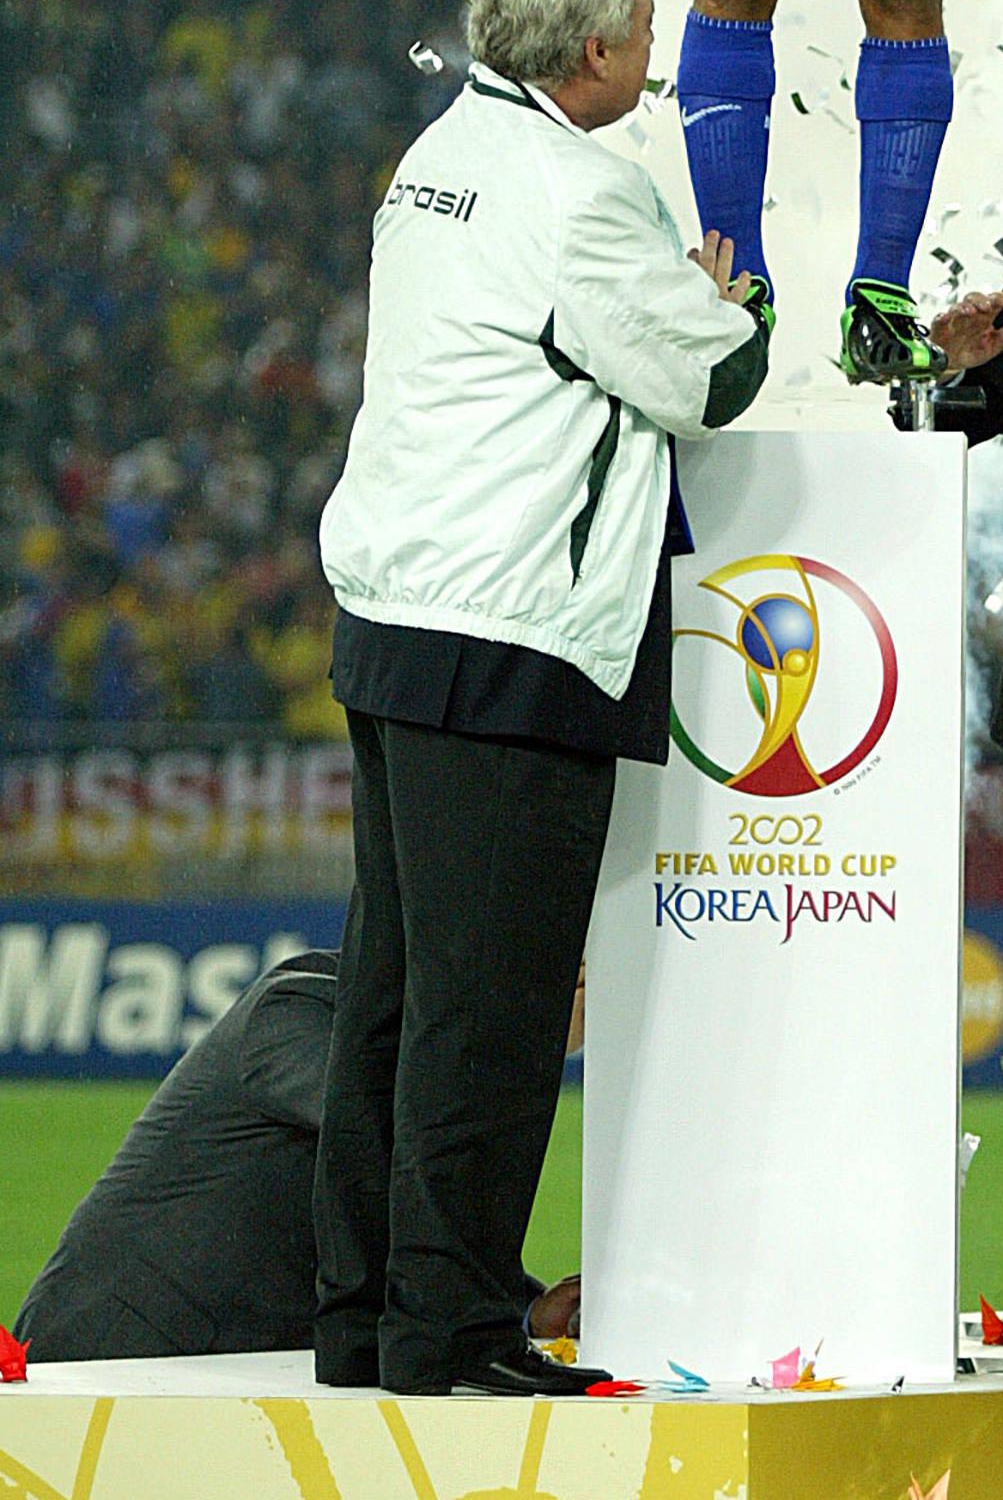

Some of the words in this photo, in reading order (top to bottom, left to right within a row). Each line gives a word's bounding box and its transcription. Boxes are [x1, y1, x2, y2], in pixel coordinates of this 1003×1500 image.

[387, 176, 478, 223] brasil
[728, 812, 824, 848] 2002
[654, 852, 719, 876] FIFA
[729, 852, 831, 876] WORLD
[841, 853, 898, 877] CUP
[653, 882, 781, 940] KOREA
[780, 883, 897, 944] JAPAN
